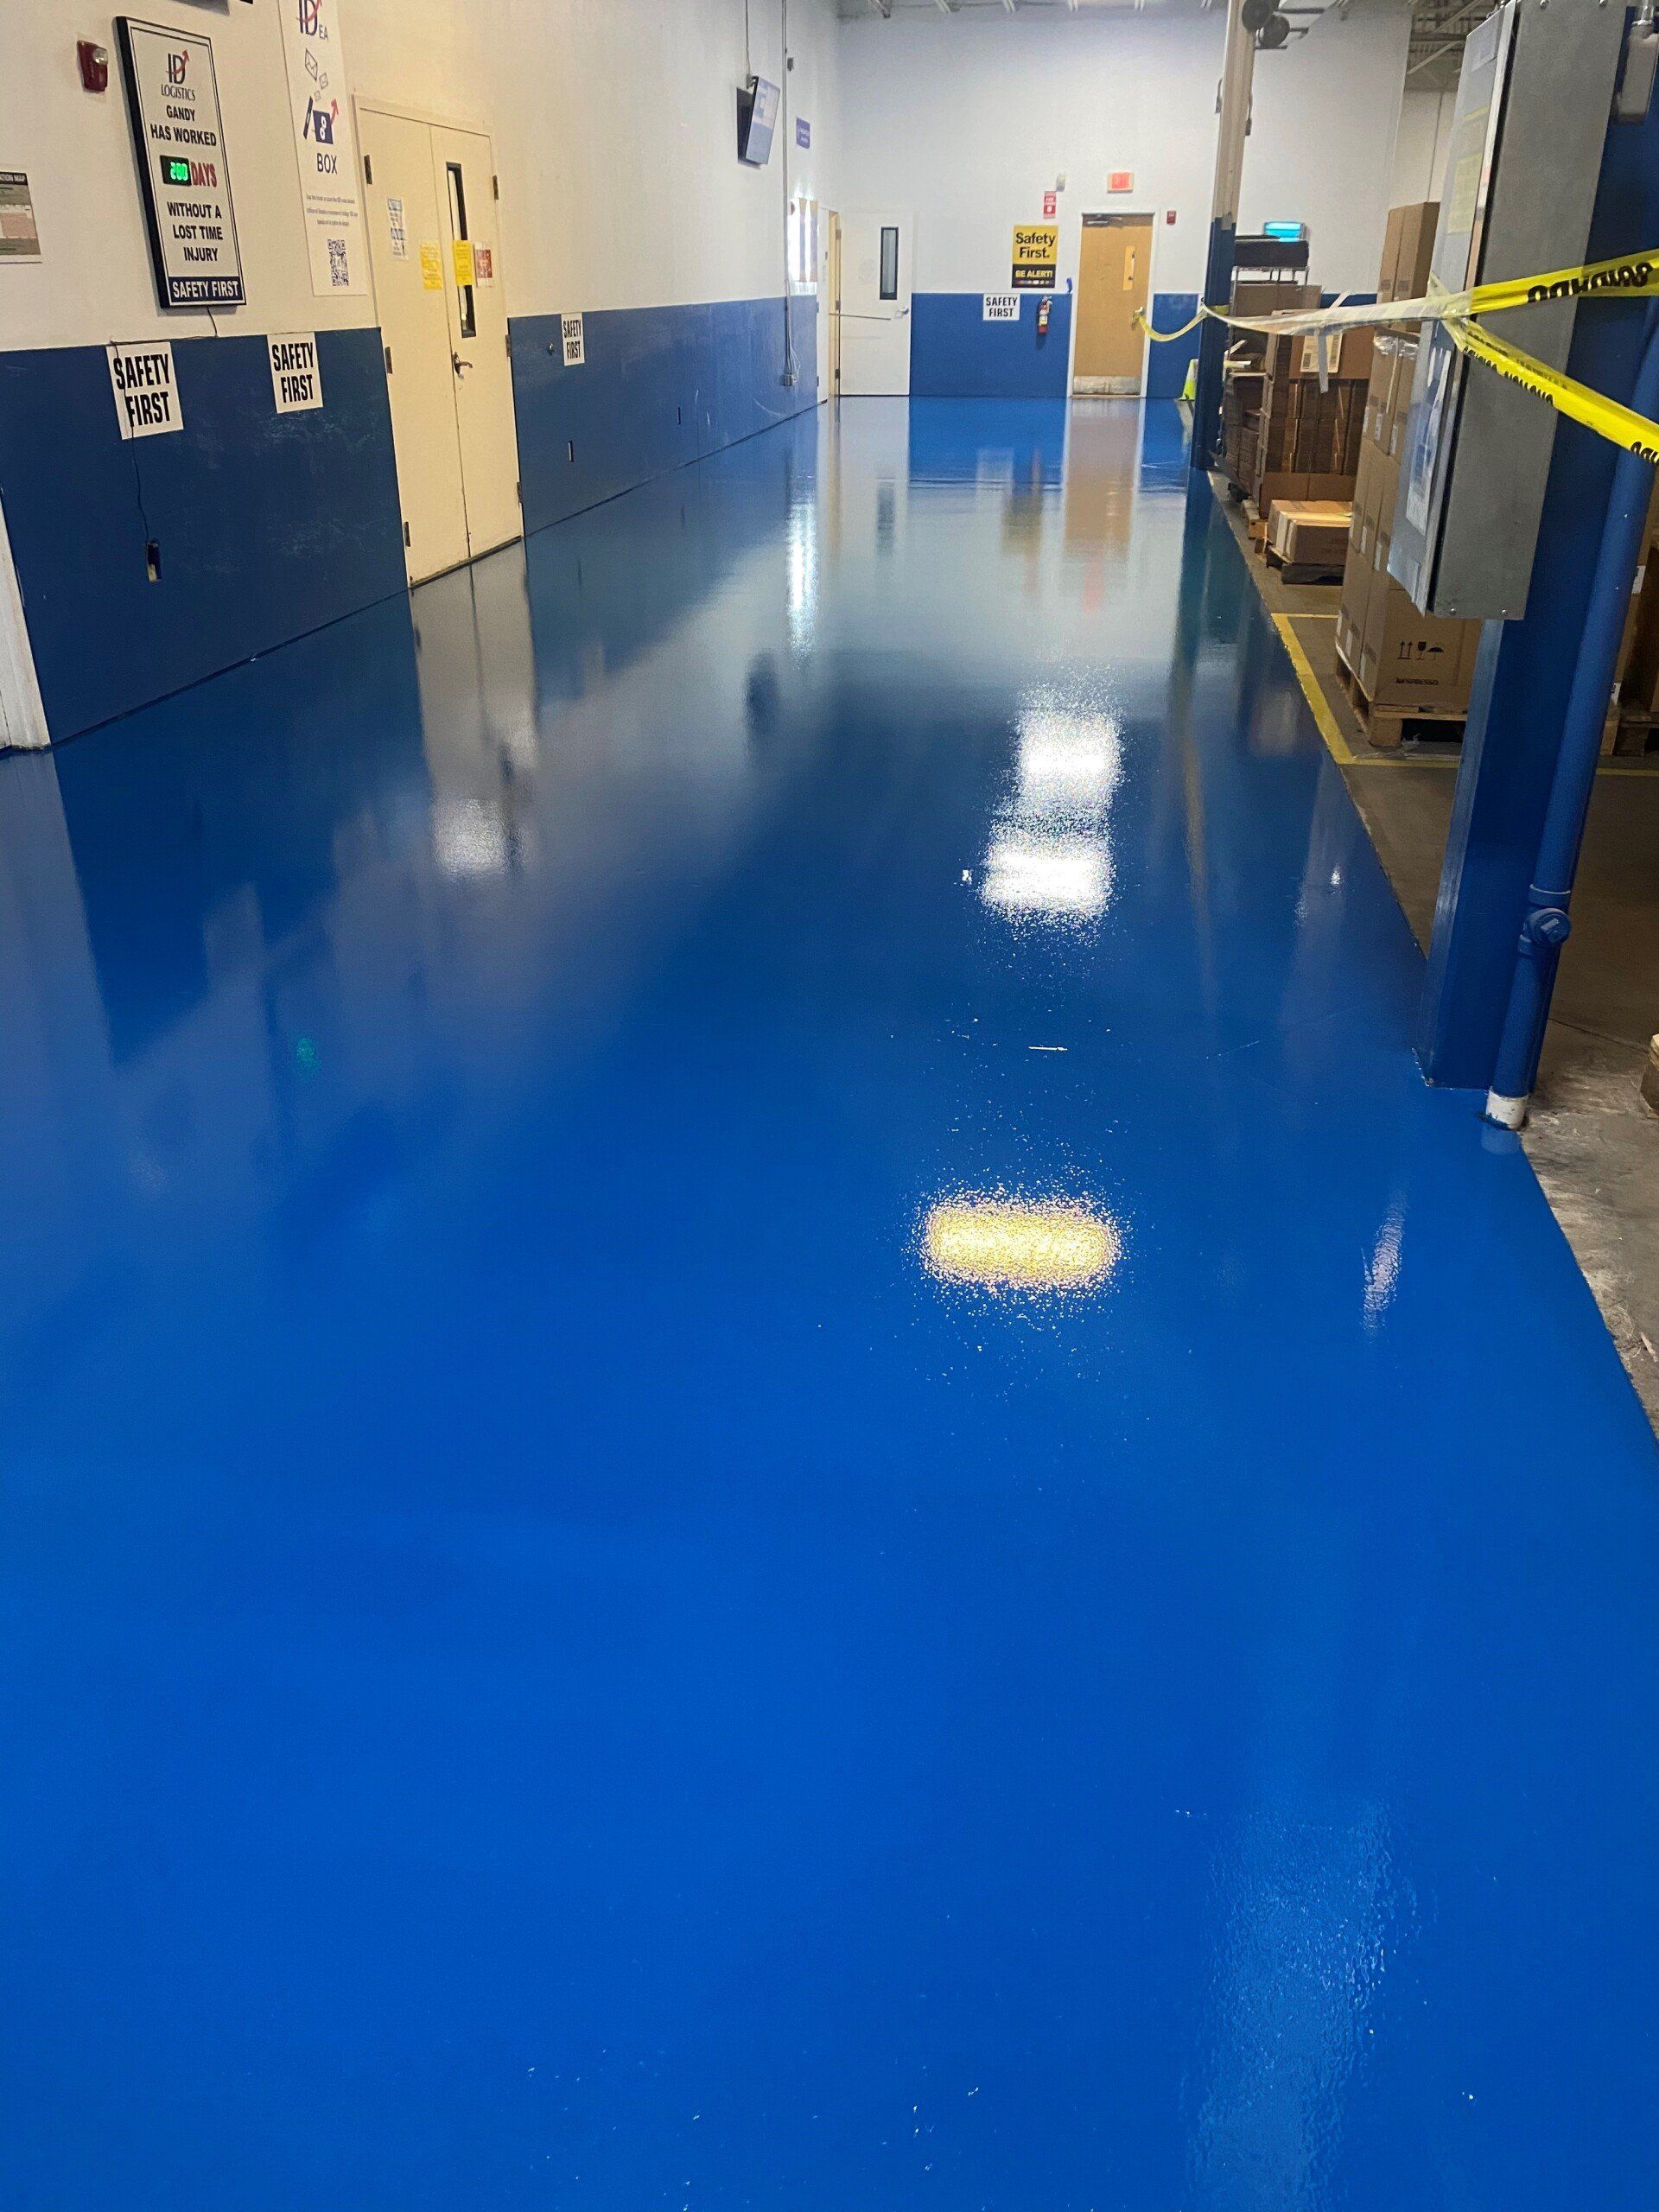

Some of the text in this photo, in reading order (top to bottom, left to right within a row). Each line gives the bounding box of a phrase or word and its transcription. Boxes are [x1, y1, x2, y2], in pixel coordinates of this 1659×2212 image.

[162, 84, 196, 101] LOGISTICS
[166, 105, 195, 122] GANDY
[150, 124, 217, 146] HAS WORKED
[316, 152, 338, 175] BOX
[190, 162, 218, 188] DAYS
[167, 201, 222, 219] WITHOUT A
[173, 224, 223, 240] LOST TIME
[1015, 232, 1056, 247] Safety
[183, 246, 218, 261] INJURY
[1020, 246, 1050, 258] First.
[1015, 270, 1053, 278] BE ALERT!
[173, 281, 238, 298] SAFETY FIRST
[986, 296, 1018, 307] SAFETY
[988, 308, 1014, 317] FIRST
[563, 320, 582, 338] SAFETY
[271, 342, 315, 372] SAFETY
[567, 340, 581, 359] FIRST
[113, 353, 170, 390] SAFETY
[280, 374, 313, 404] FIRST
[124, 391, 171, 428] FIRST
